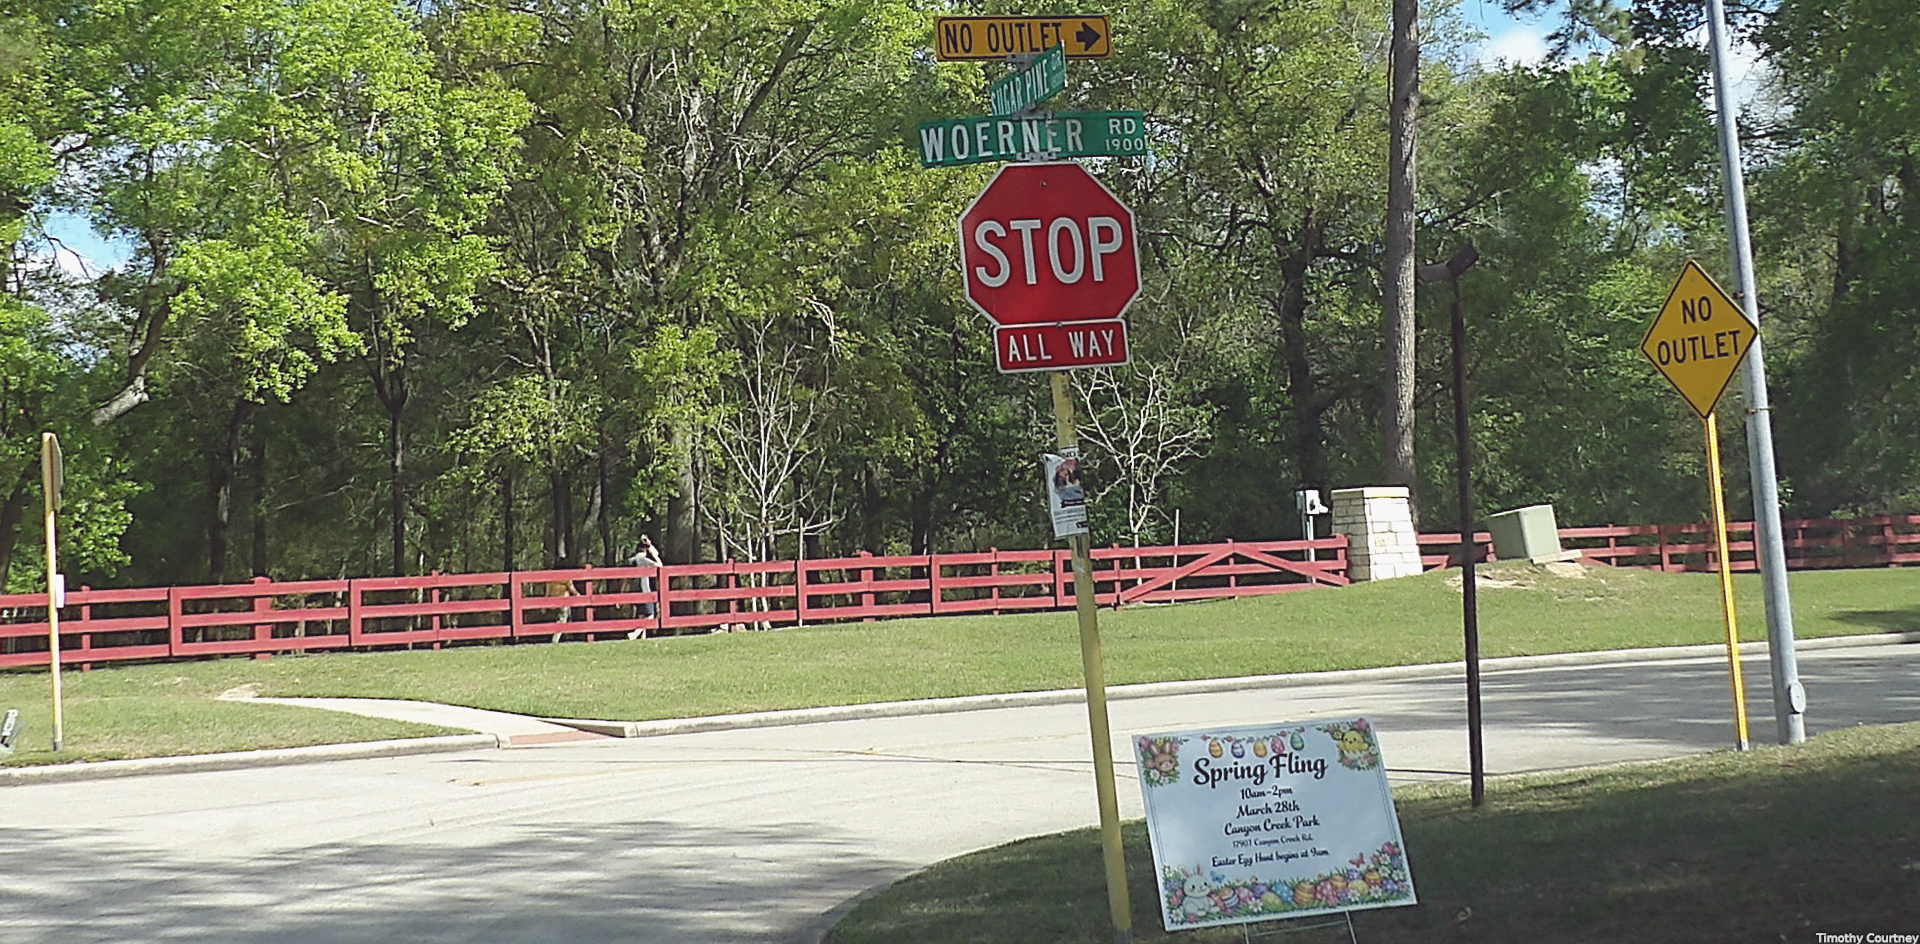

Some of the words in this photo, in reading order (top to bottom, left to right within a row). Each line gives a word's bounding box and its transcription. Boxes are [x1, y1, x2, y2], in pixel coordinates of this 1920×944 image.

[944, 23, 972, 53] NO
[987, 22, 1062, 52] OUTLET
[991, 76, 1023, 115] SUGAR
[1025, 59, 1050, 103] PINE
[1051, 50, 1062, 70] DR
[919, 118, 1084, 163] WOERNER
[1108, 118, 1136, 134] RD
[1104, 138, 1143, 153] 1900
[974, 216, 1123, 288] STOP
[1681, 296, 1712, 324] NO
[1008, 333, 1052, 362] ALL
[1068, 329, 1114, 358] WAY
[1657, 330, 1740, 366] OUTLET
[1193, 757, 1268, 789] Spring
[1268, 752, 1328, 779] Fling
[1236, 803, 1273, 819] March
[1274, 800, 1300, 813] 28th
[1224, 822, 1261, 837] Canyon
[1263, 817, 1291, 832] Creek
[1292, 815, 1320, 829] Park
[1254, 838, 1280, 847] Canyon
[1280, 834, 1301, 844] Creek
[1211, 856, 1237, 868] Easter
[1238, 854, 1253, 867] Egg
[1255, 852, 1274, 864] Hunt
[1275, 850, 1299, 863] begins
[1300, 850, 1309, 858] at
[1310, 847, 1329, 857] 9am
